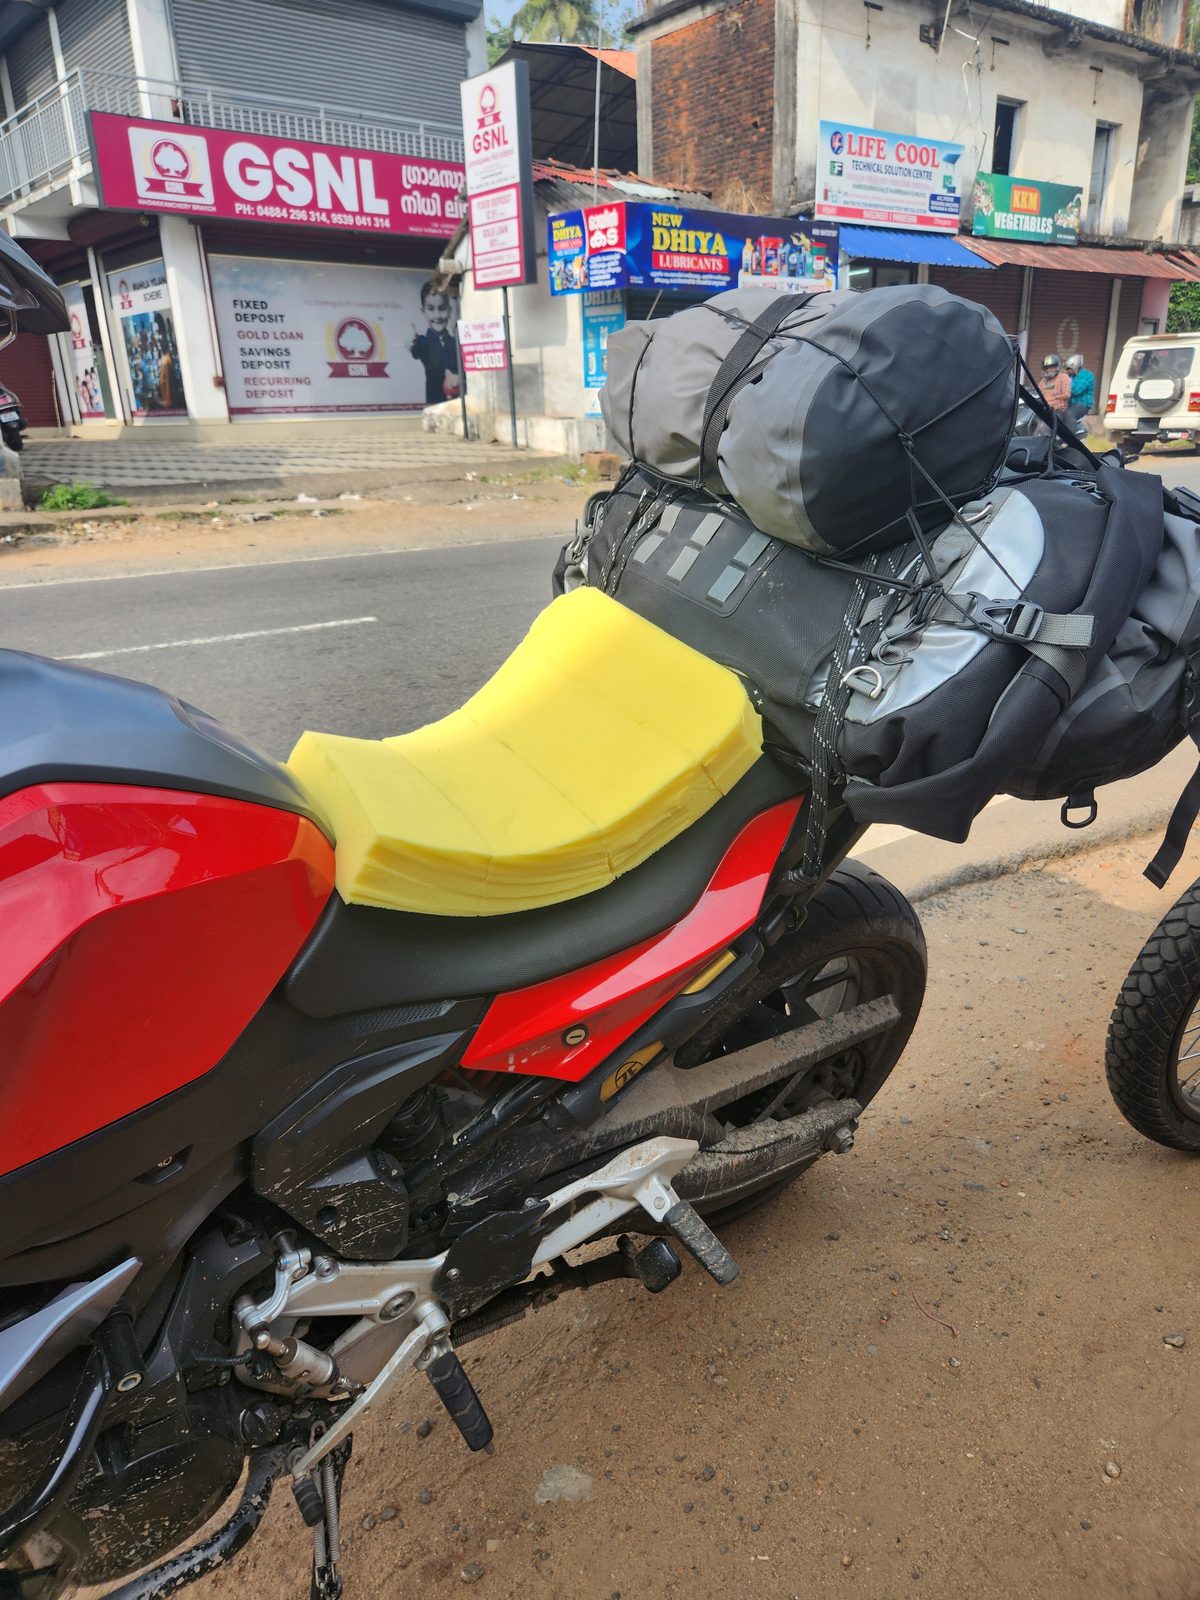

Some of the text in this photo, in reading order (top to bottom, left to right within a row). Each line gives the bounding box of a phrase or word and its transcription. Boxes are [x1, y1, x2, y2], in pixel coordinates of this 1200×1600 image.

[472, 125, 508, 154] GSNL
[847, 133, 940, 168] LIFE COOL
[852, 160, 933, 180] TECHNICAL SOLUTION CENTRE
[223, 142, 390, 216] GSNL
[1012, 190, 1038, 210] KKM
[234, 203, 255, 215] PH:
[373, 217, 391, 228] 314
[652, 212, 683, 227] NEW
[994, 211, 1053, 234] VEGETABLES
[553, 225, 582, 241] DHIYA
[652, 227, 728, 256] DHIYA
[659, 254, 723, 271] LUBRICANTS
[233, 299, 268, 310] FIXED
[235, 313, 285, 324] DEPOSIT
[237, 330, 304, 341] GOLD LOAN
[240, 347, 291, 357] SAVINGS
[241, 360, 291, 370] DEPOSIT
[244, 376, 311, 386] RECURRING
[245, 389, 295, 399] DEPOSIT
